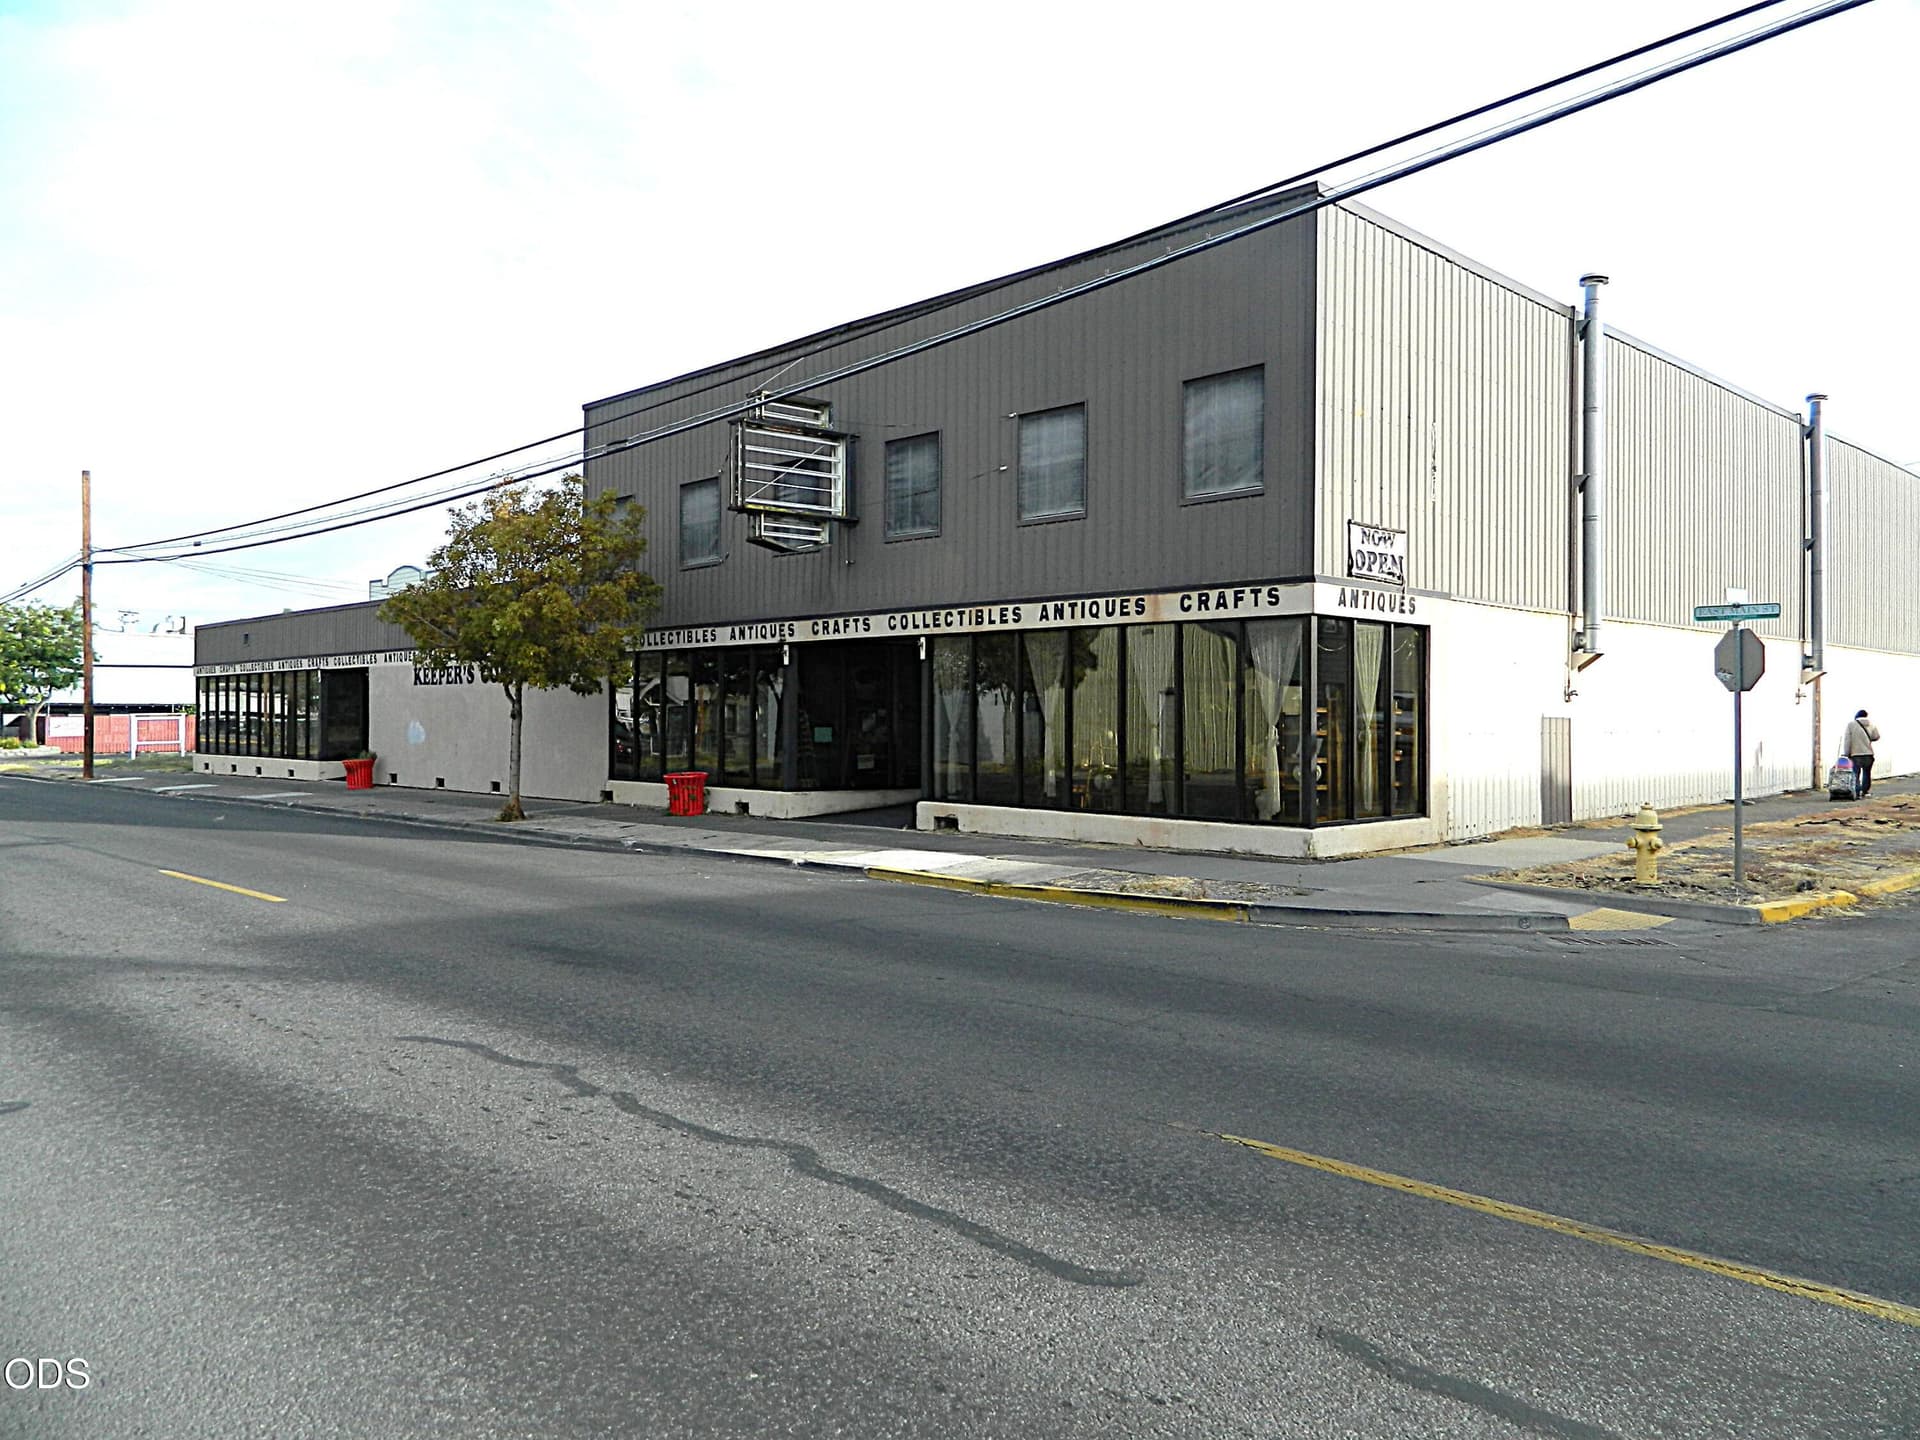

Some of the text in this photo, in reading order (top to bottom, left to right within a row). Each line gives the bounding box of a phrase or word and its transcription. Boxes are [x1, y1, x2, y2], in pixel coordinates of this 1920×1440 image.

[1360, 527, 1396, 549] NOW
[1355, 548, 1404, 581] OPEN
[1338, 587, 1417, 615] ANTIQUES
[1699, 606, 1725, 616] EAST
[1762, 604, 1777, 613] ST
[633, 586, 1281, 648] OLLECTIBLES ANTIQUES CRAFTS COLLECTIBLES ANTIQUES CRAFTS
[278, 657, 303, 669] ANTIQUES
[307, 656, 329, 668] CRAFTS
[333, 653, 378, 667] COLLECTIBLES
[413, 664, 475, 686] KEEPER'S
